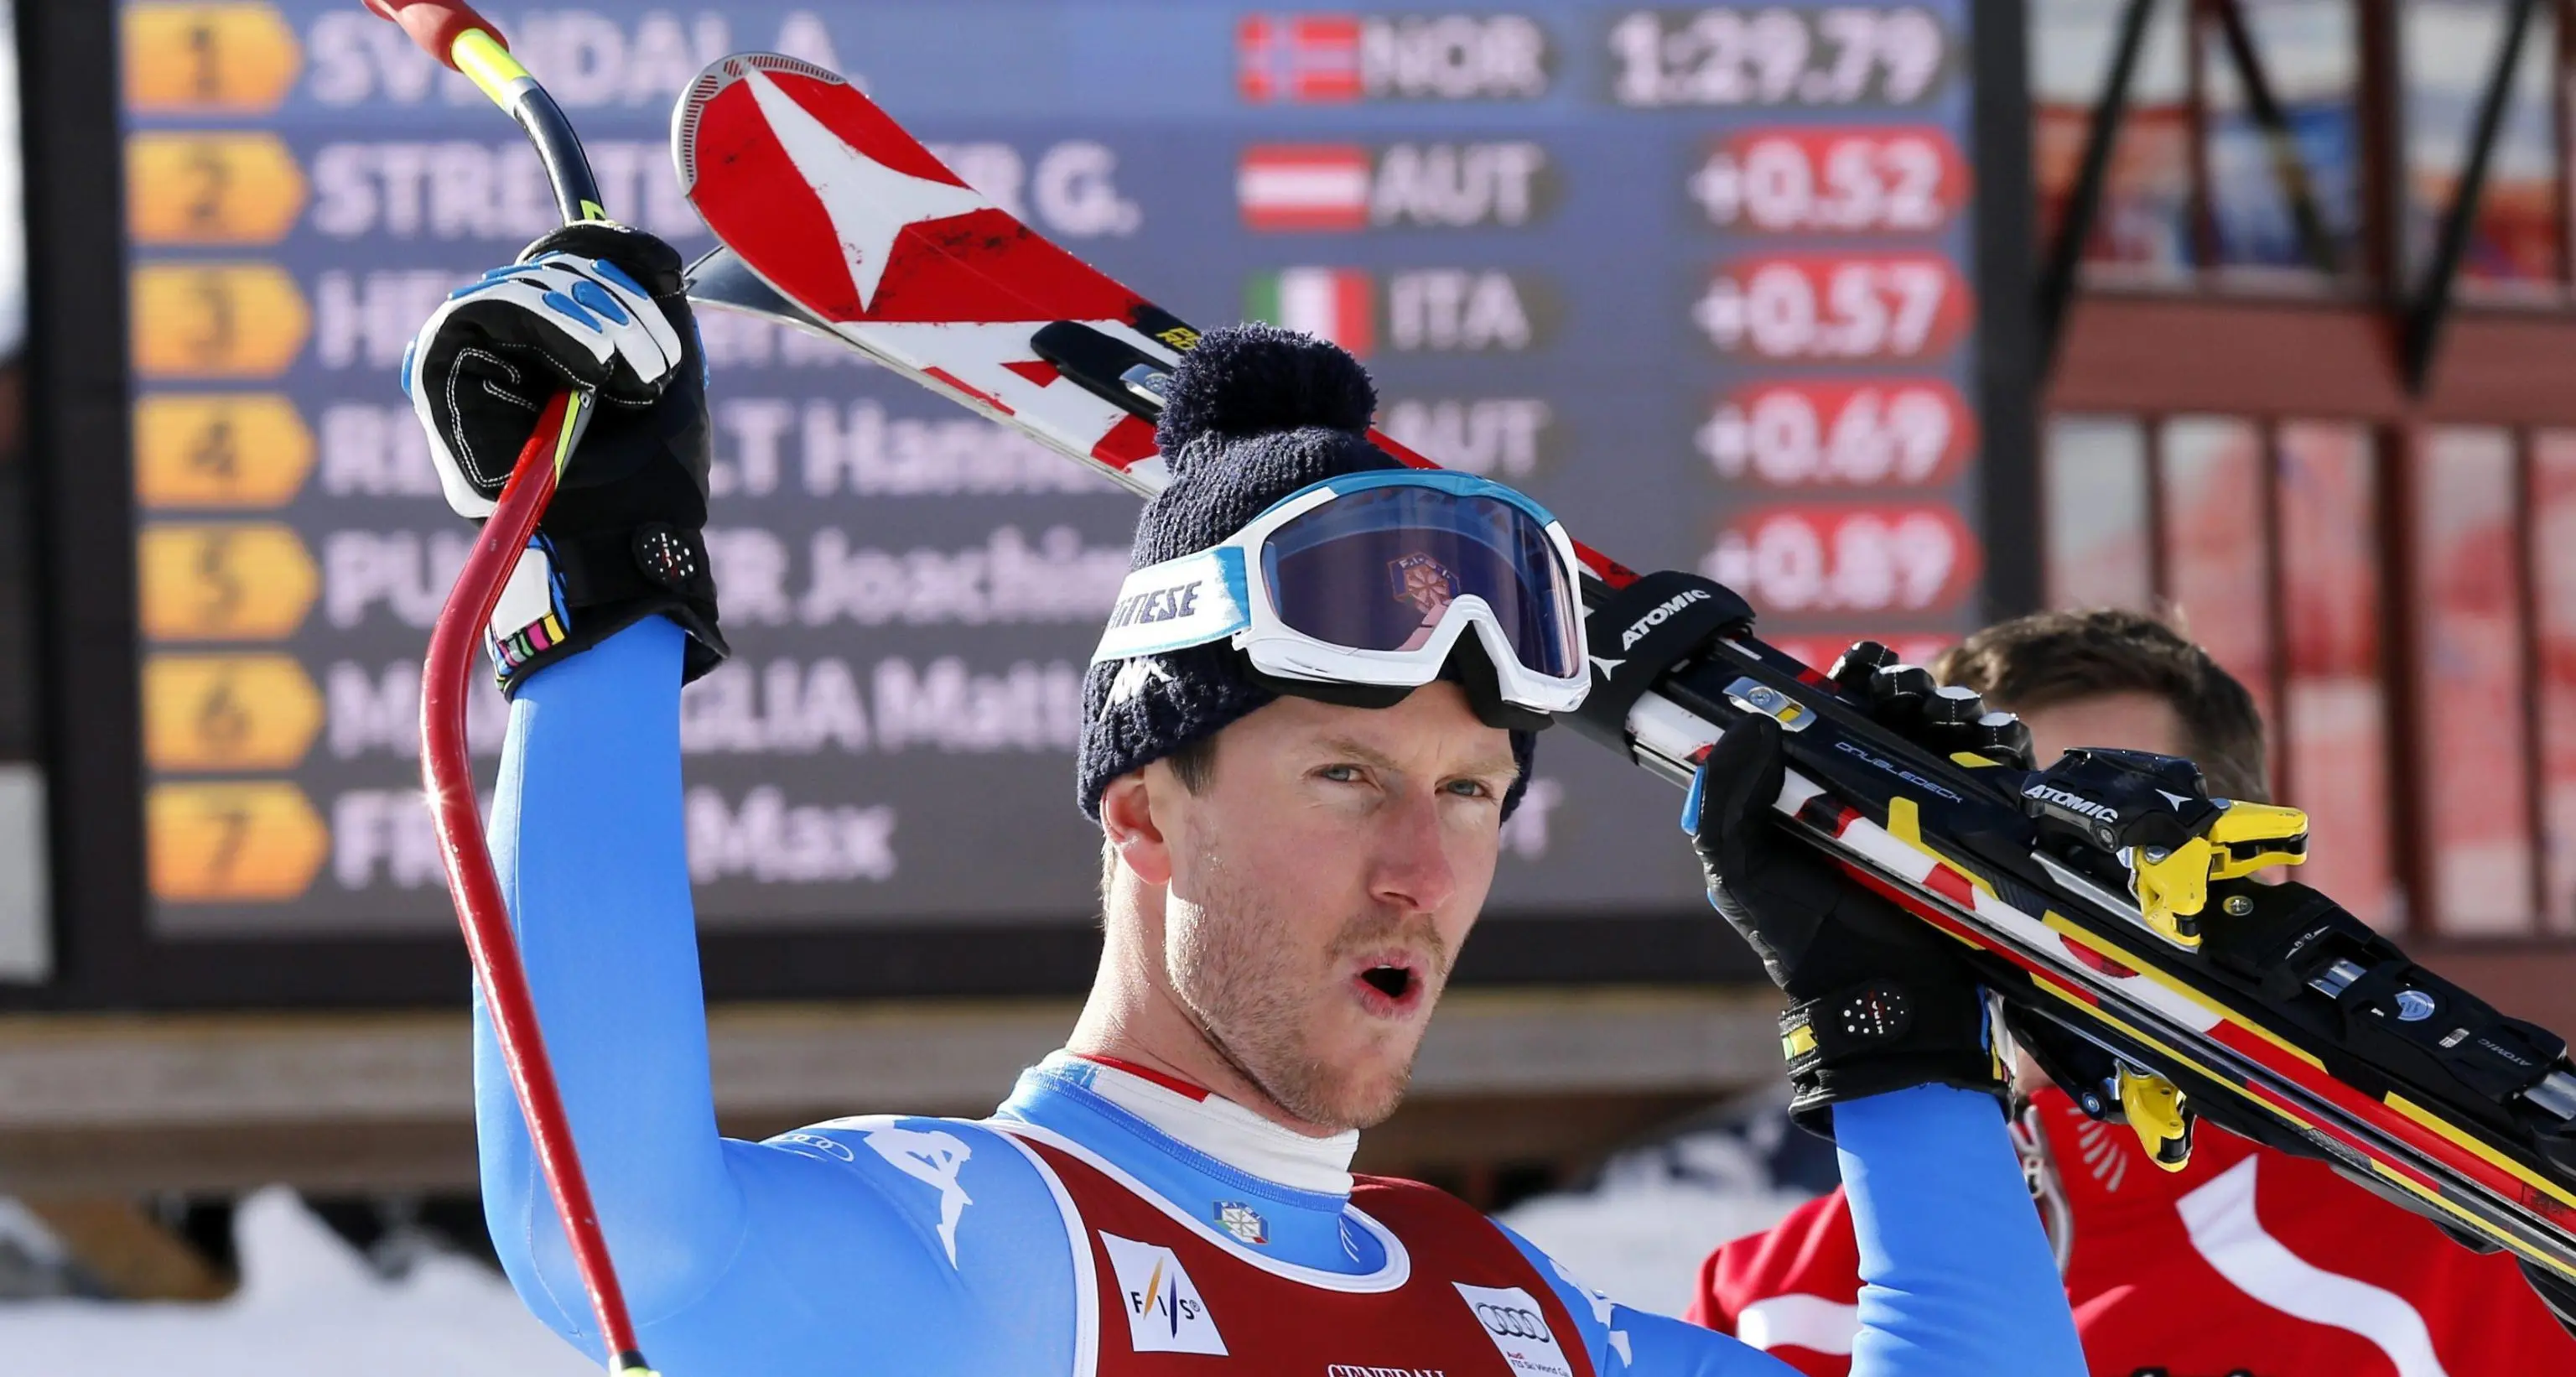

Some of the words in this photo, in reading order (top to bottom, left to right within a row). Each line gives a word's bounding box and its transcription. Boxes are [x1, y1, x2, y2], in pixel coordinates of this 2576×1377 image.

[185, 20, 221, 101] 1
[1359, 13, 1547, 100] NOR
[1609, 10, 1940, 106] 1:29.79
[179, 144, 232, 231] 2
[1372, 141, 1547, 226] AUT
[1690, 138, 1943, 231] +0.52
[188, 273, 237, 363] 3
[1389, 268, 1533, 351] ITA
[1692, 262, 1945, 356] +0.57
[186, 412, 239, 483] 4
[1695, 389, 1953, 483] +0.69
[194, 534, 243, 625] 5
[1700, 517, 1959, 611] +0.89
[1622, 589, 1711, 652] ATOMIC
[195, 675, 252, 756] 6
[1835, 741, 1963, 804] DOUBLEDECK
[2023, 784, 2119, 824] ATOMIC
[198, 797, 252, 884] 7
[685, 785, 898, 886] Max
[2477, 1038, 2533, 1067] ATOMIC
